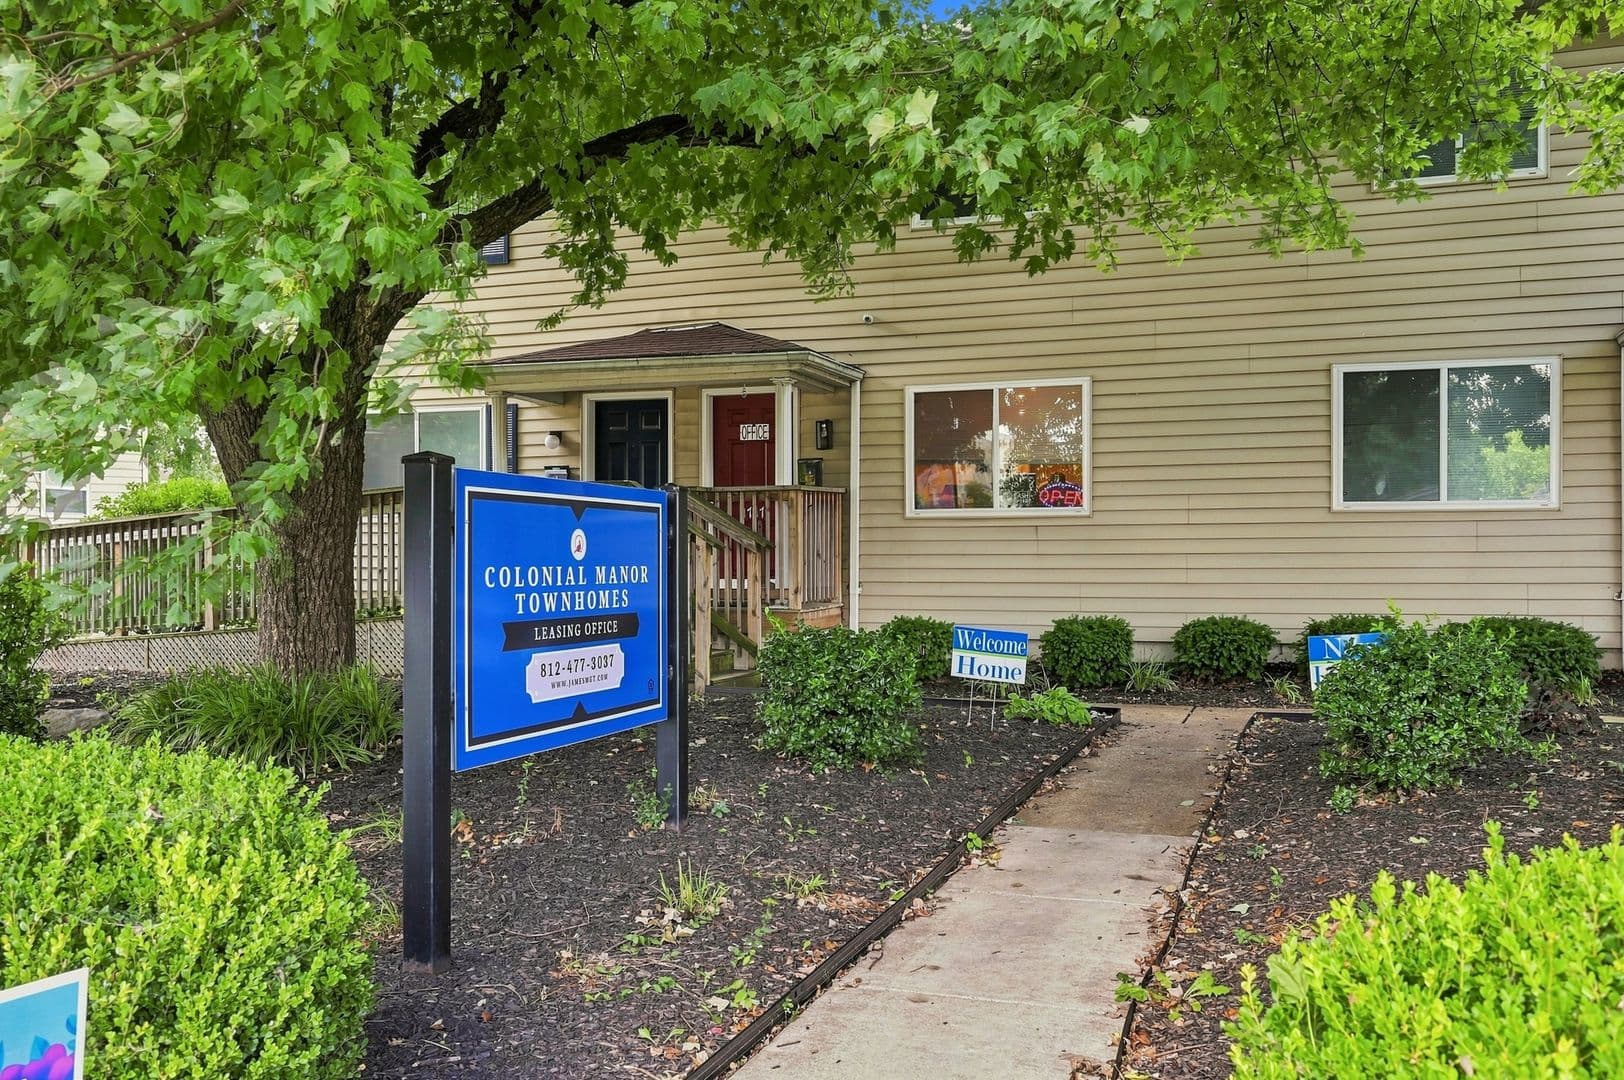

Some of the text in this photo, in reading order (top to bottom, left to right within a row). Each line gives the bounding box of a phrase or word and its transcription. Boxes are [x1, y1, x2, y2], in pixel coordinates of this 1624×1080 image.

[741, 425, 768, 439] OFFICE
[1040, 490, 1084, 505] OPEN
[485, 565, 649, 588] COLONIAL MANOR
[515, 589, 629, 614] TOWNHOMES
[534, 620, 618, 641] LEASING OFFICE
[957, 629, 1026, 655] Welcome
[540, 654, 615, 677] 812-477-3037
[956, 655, 1022, 681] Home
